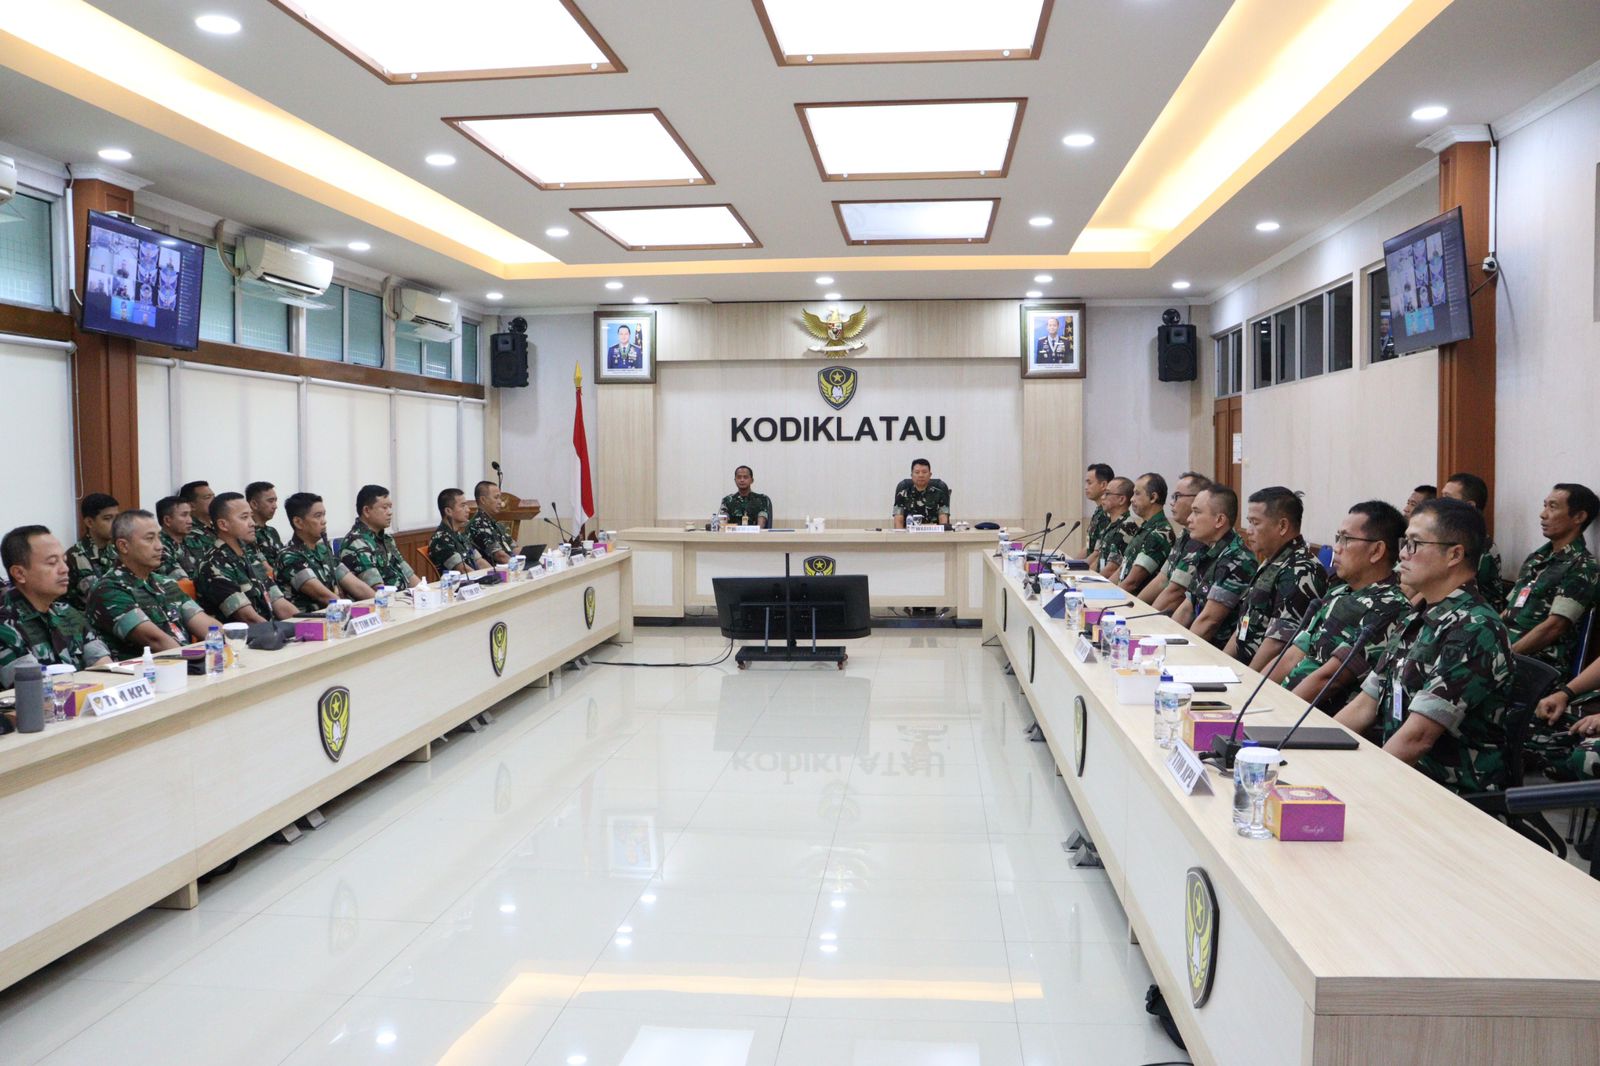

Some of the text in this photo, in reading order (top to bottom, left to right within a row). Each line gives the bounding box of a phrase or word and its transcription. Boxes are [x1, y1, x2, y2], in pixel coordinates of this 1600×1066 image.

[731, 416, 946, 442] KODIKLATAU
[127, 684, 150, 699] KPL
[1171, 751, 1196, 788] TIM KPL
